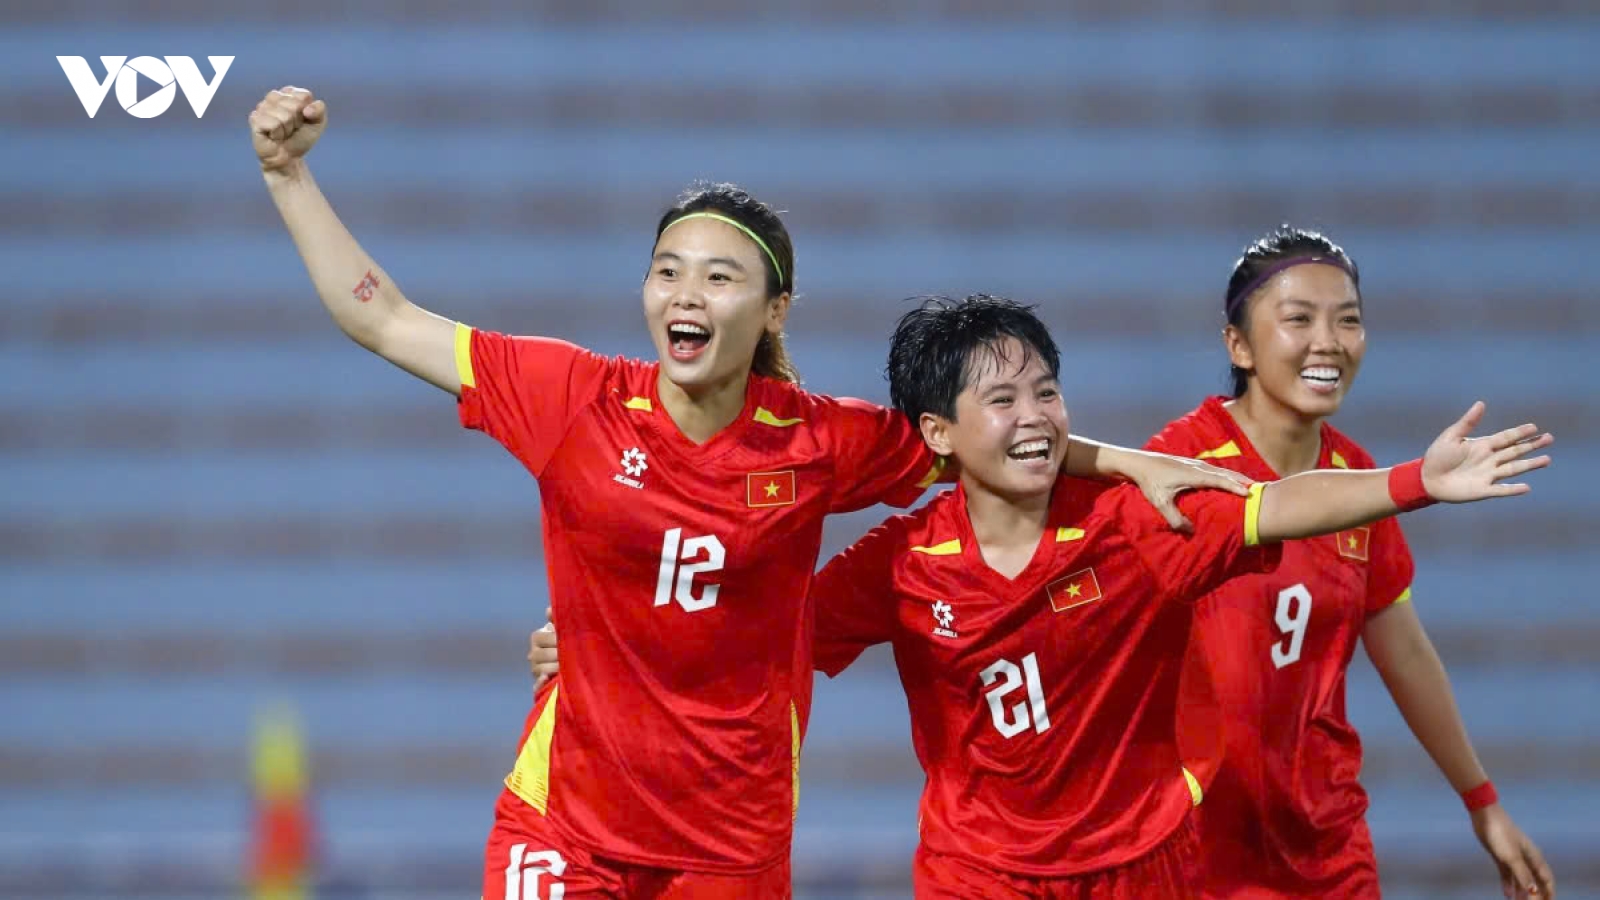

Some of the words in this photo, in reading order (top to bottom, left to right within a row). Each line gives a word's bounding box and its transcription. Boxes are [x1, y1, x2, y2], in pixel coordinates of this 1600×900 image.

[654, 527, 726, 612] 12
[1271, 583, 1312, 669] 9
[979, 652, 1050, 738] 21
